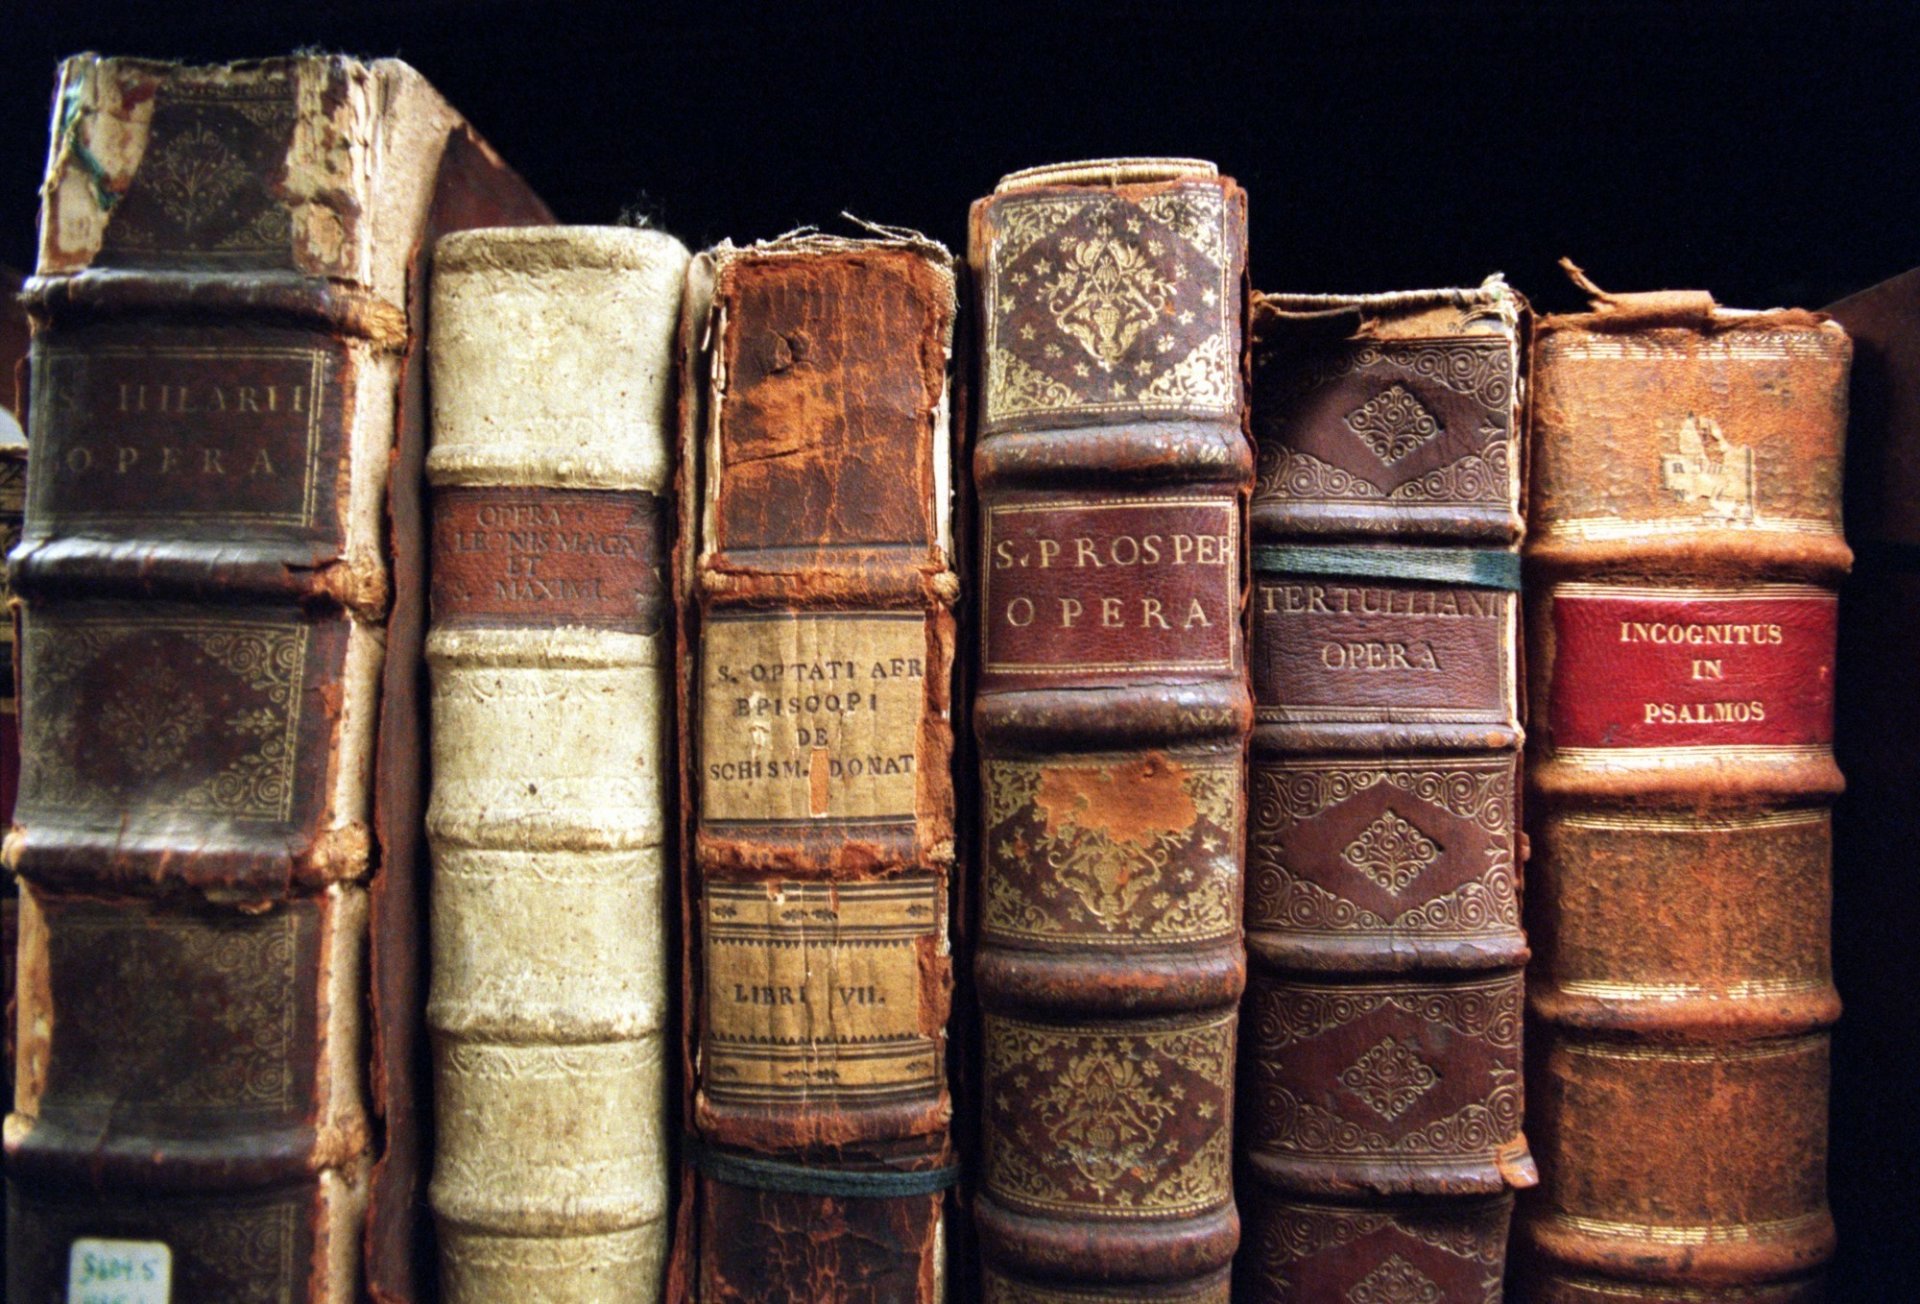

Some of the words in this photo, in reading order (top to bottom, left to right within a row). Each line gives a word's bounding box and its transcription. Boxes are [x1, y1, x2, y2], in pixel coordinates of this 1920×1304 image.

[65, 446, 275, 475] OPERA
[476, 505, 563, 528] OPERA
[1038, 532, 1234, 569] PROSPER
[1005, 596, 1211, 630] OPERA
[1258, 584, 1501, 618] TERTULLIANI
[1620, 621, 1783, 645] INCOGNITUS
[1321, 640, 1444, 672] OPERA
[717, 664, 739, 684] S.
[750, 661, 855, 683] OPTATI
[870, 658, 924, 679] AFR
[1691, 659, 1723, 680] IN
[735, 691, 877, 716] EPISCOPI
[1643, 700, 1766, 724] PSALMOS
[797, 727, 829, 746] DE
[709, 759, 809, 781] SCHISM.
[829, 754, 914, 777] DONAT
[734, 983, 807, 1006] LIBRI
[838, 985, 885, 1006] VII.
